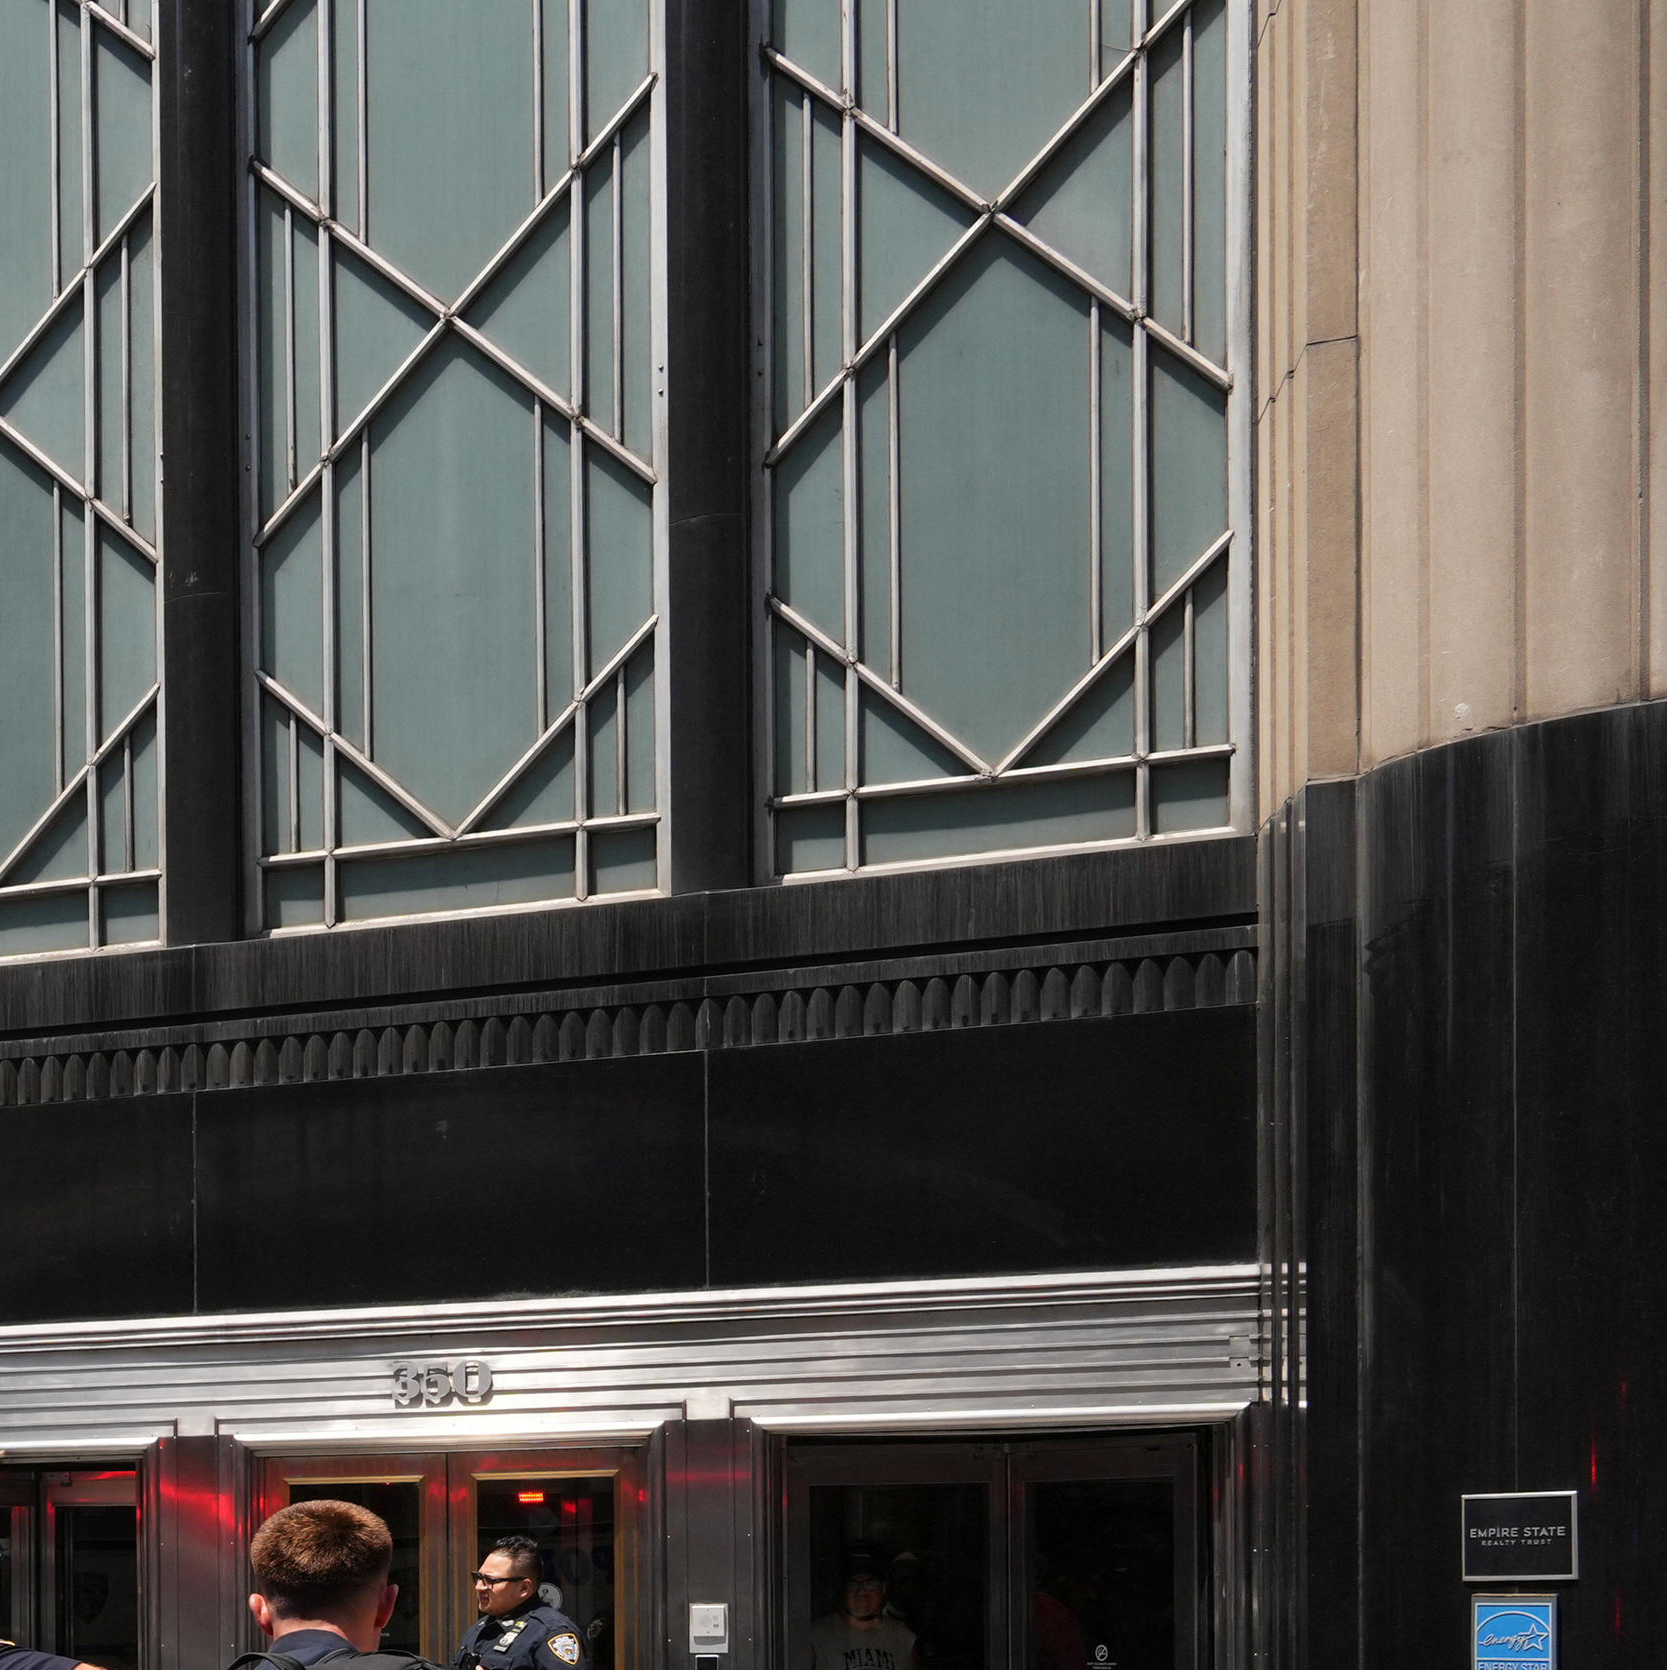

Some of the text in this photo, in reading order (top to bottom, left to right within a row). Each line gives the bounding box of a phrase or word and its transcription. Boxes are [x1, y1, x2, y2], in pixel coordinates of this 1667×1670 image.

[392, 1361, 492, 1401] 350
[1470, 1526, 1566, 1539] EMPIRE STATE
